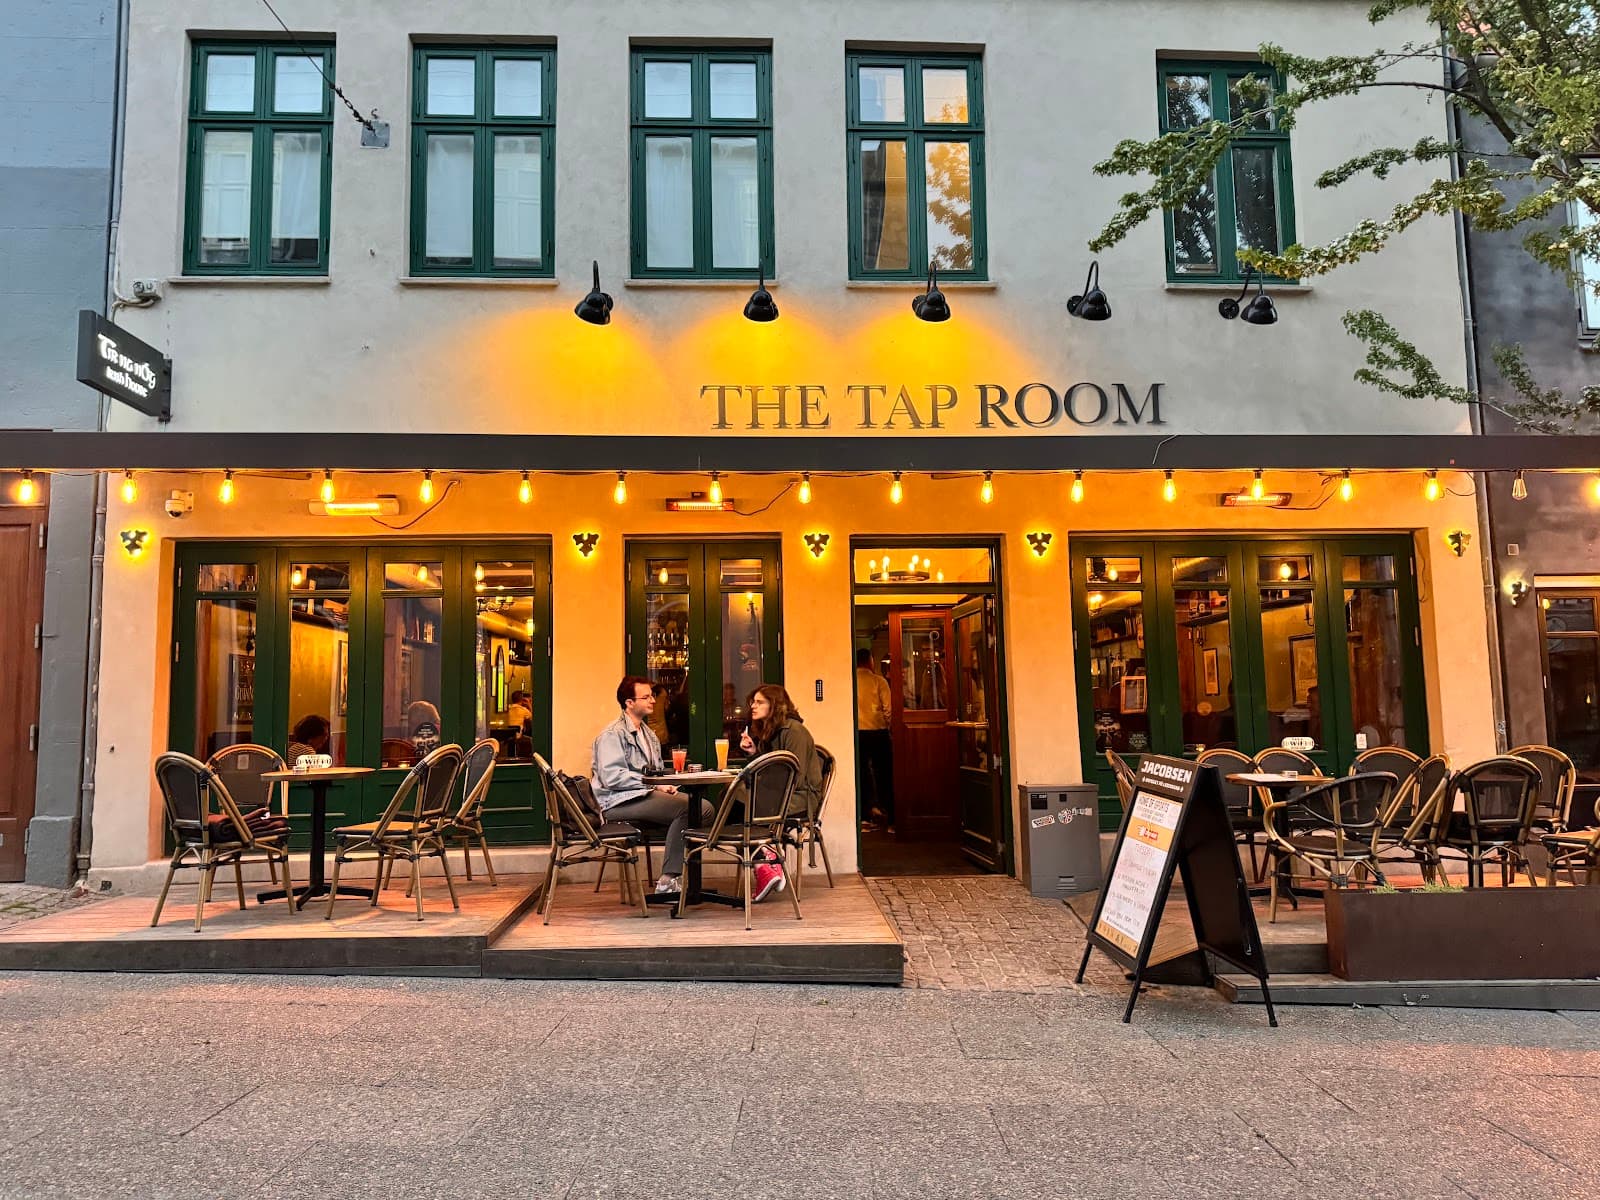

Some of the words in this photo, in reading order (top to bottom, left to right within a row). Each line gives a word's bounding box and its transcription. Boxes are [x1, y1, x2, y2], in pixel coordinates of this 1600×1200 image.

[700, 384, 830, 429] THE
[848, 384, 958, 429] TAP
[974, 383, 1168, 428] ROOM
[1141, 761, 1192, 783] JACOBSEN
